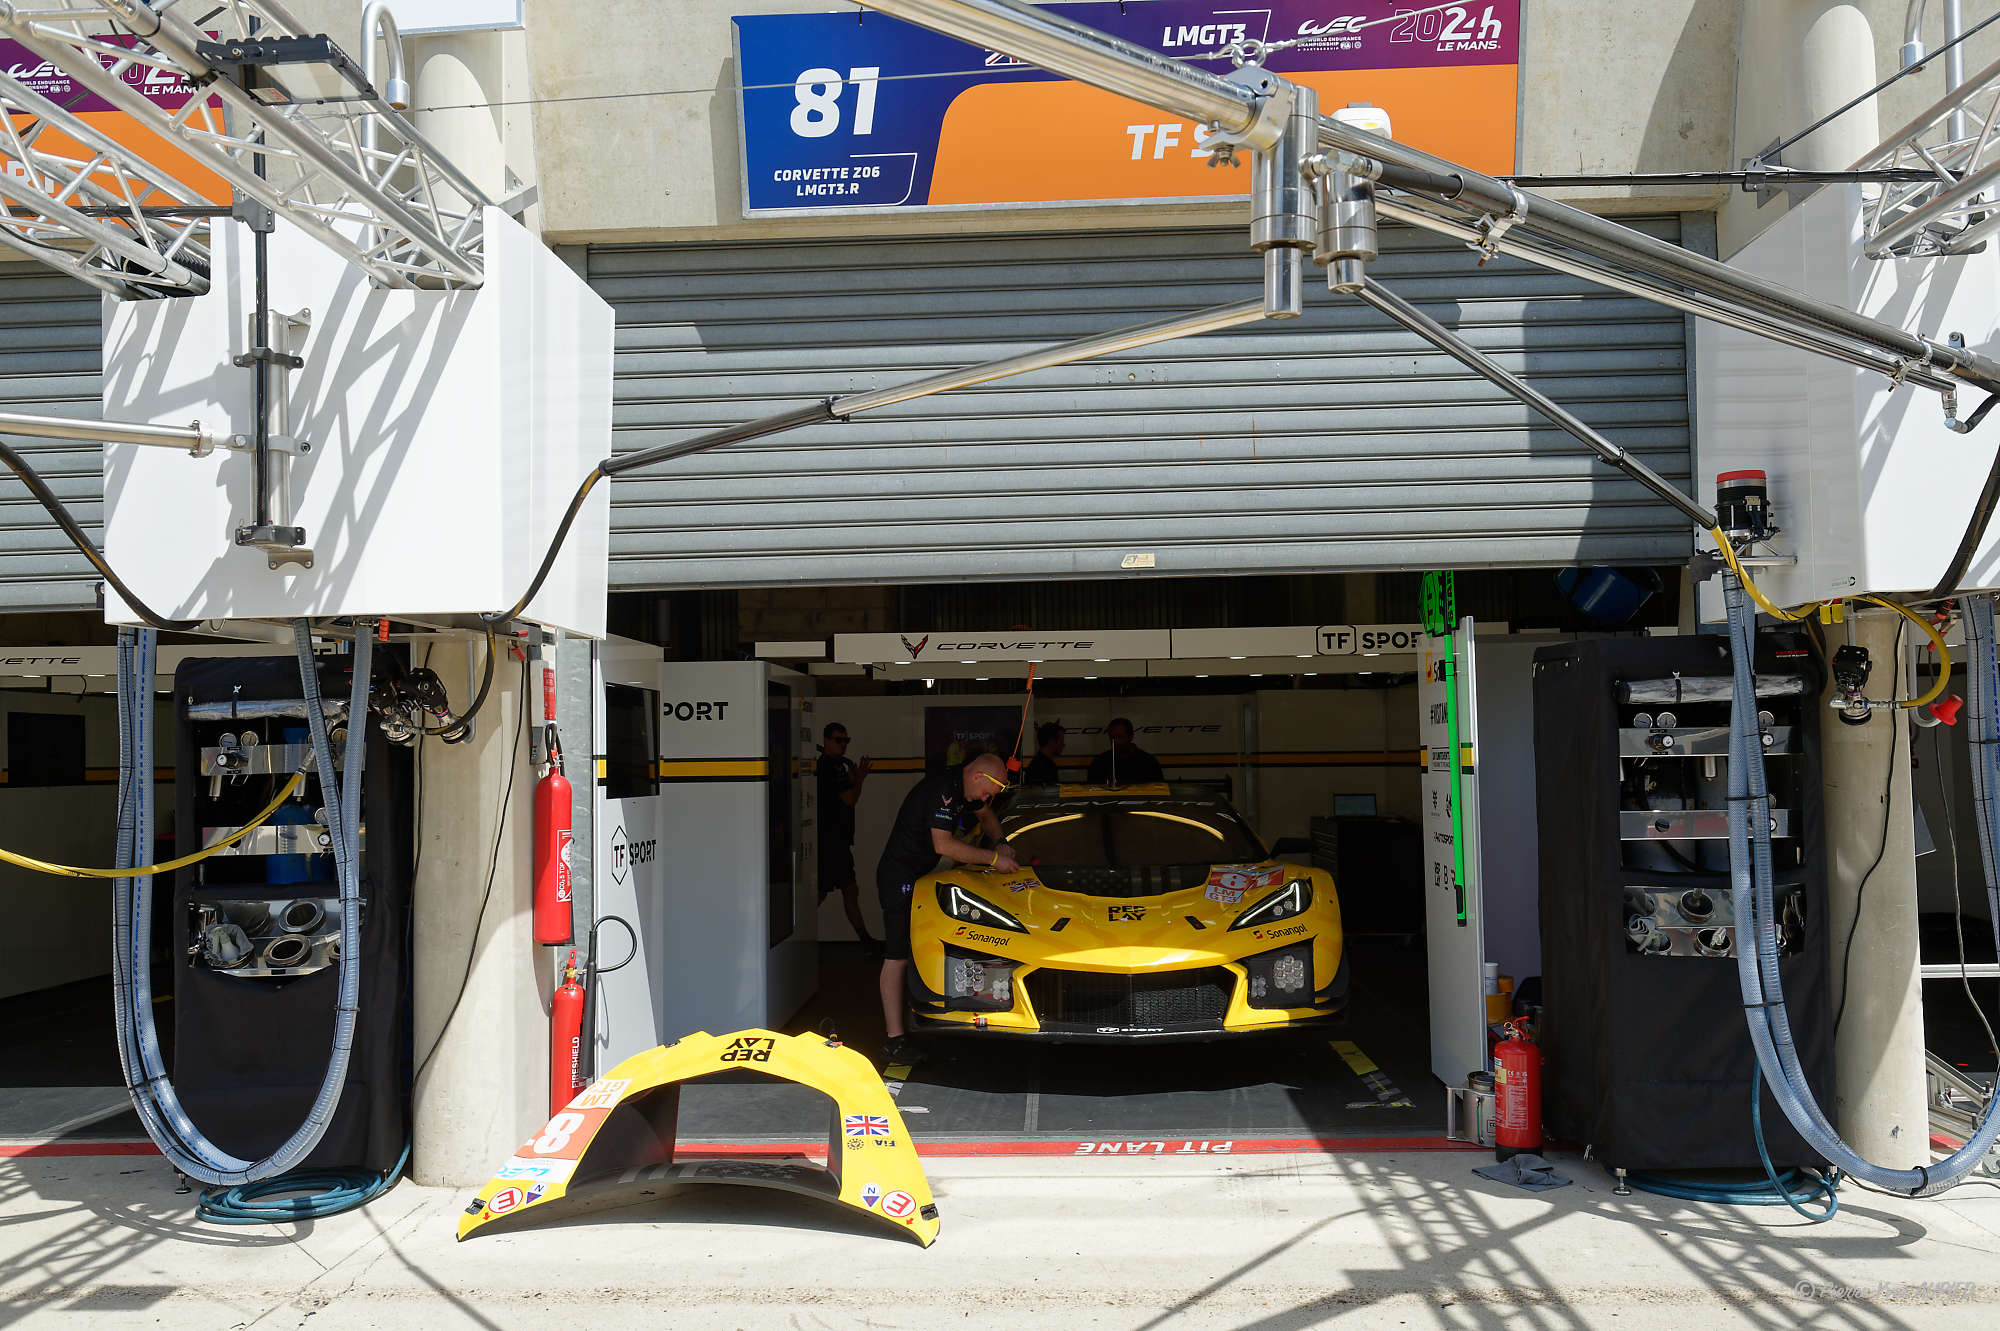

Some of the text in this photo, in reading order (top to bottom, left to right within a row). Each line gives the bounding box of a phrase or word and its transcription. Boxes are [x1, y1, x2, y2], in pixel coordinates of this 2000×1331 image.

[1162, 24, 1247, 47] LMGT3
[1437, 41, 1502, 51] LE MANS
[143, 84, 195, 95] LE MAN
[790, 67, 880, 138] 81
[1127, 124, 1182, 160] TF
[774, 166, 880, 182] CORVETTE Z06
[796, 183, 860, 197] LMGT3.R
[937, 641, 1095, 650] CORVETTE
[1322, 632, 1351, 650] TF
[613, 839, 657, 868] TF SPORT
[1108, 905, 1146, 914] REP
[1108, 913, 1146, 922] LAY
[967, 931, 1011, 946] Sonangol
[1266, 924, 1308, 940] Sonangol
[726, 1037, 776, 1050] LAY
[571, 1036, 580, 1089] FIRESHIELD
[720, 1049, 772, 1062] REP
[524, 1112, 585, 1154] 8
[1075, 1141, 1233, 1154] PIT LANE
